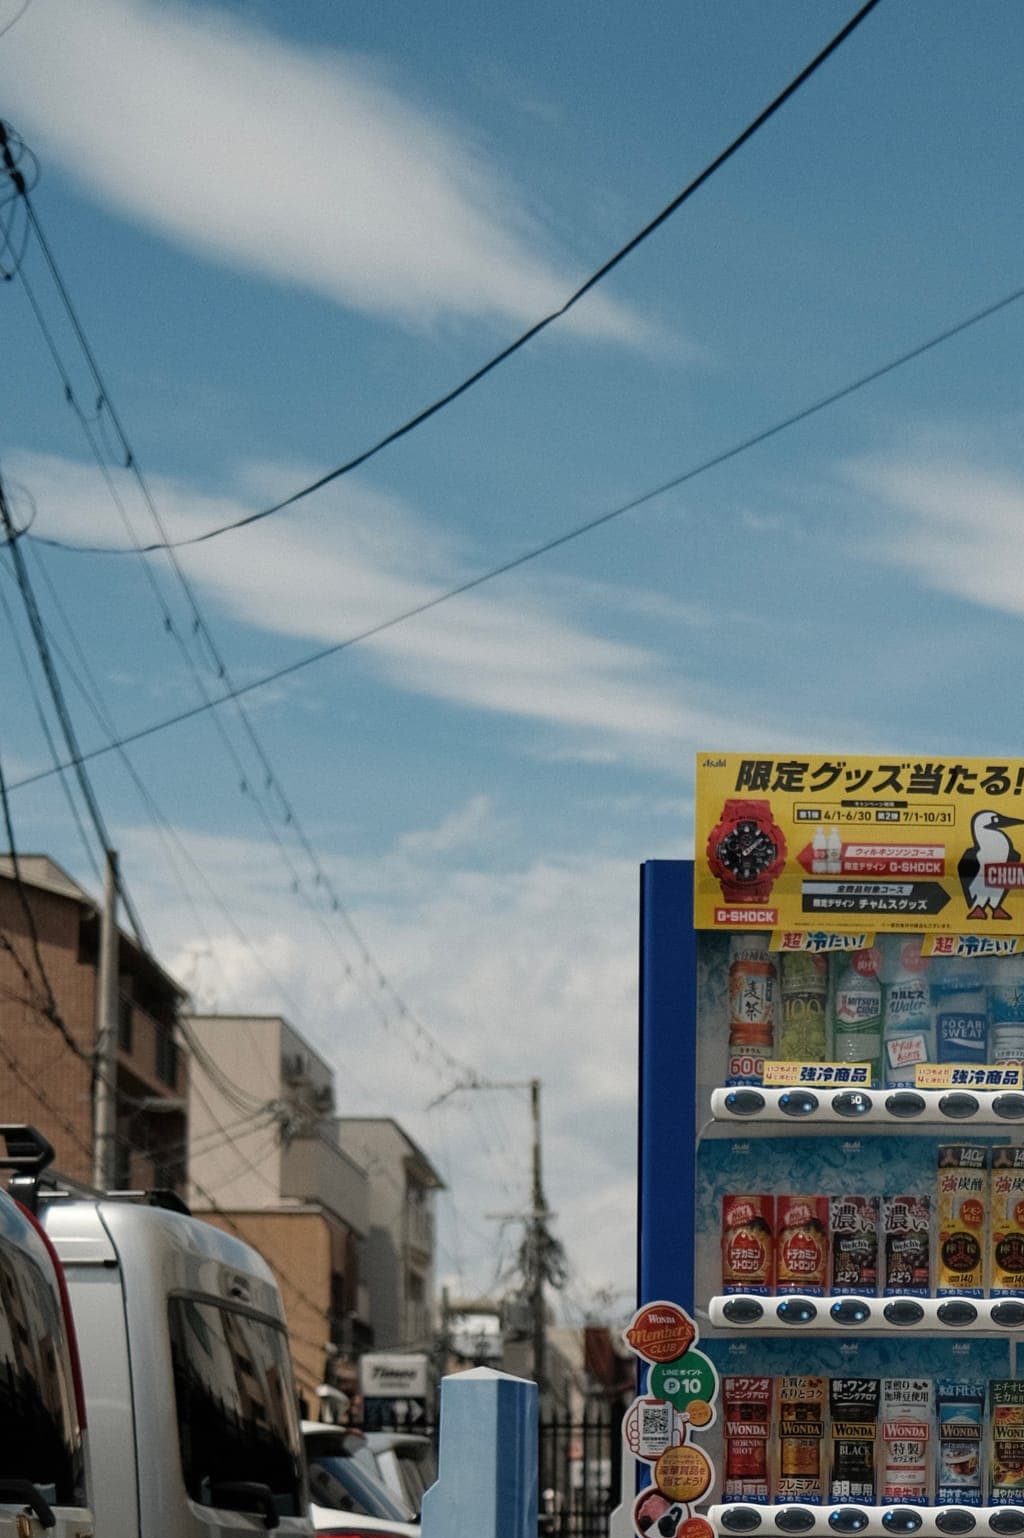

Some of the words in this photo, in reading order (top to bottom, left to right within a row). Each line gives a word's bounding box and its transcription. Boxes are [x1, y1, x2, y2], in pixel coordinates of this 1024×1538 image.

[823, 811, 872, 822] 4/1-6/30
[903, 813, 952, 824] 7/1-10/31
[890, 862, 942, 873] G-SHOCK
[717, 910, 775, 923] G-SHOCK
[743, 980, 763, 1021] 麦茶
[891, 991, 925, 999] カルピス
[941, 1029, 983, 1038] SWEAT
[730, 1058, 764, 1076] 600
[800, 1066, 868, 1082] 強冷商品
[951, 1069, 1019, 1085] 強冷商品
[941, 1175, 984, 1192] 強炭酸
[730, 1248, 761, 1260] ドデカミン
[787, 1248, 817, 1260] ドデカミン
[731, 1260, 760, 1270] ストロング
[787, 1260, 816, 1271] ストロング
[648, 1314, 676, 1324] WONDA
[650, 1343, 677, 1354] CLUB
[681, 1379, 701, 1394] 10
[780, 1388, 823, 1400] 香りとコク
[884, 1392, 929, 1402] 珈琲豆使用
[727, 1422, 767, 1436] WONDA
[782, 1421, 821, 1435] WONDA
[835, 1423, 873, 1437] WONDA
[886, 1424, 926, 1437] WONDA
[941, 1425, 980, 1437] WONDA
[839, 1445, 871, 1456] BLACK
[893, 1443, 920, 1456] 特製
[779, 1480, 821, 1490] プレミアム
[832, 1480, 873, 1496] 朝専用
